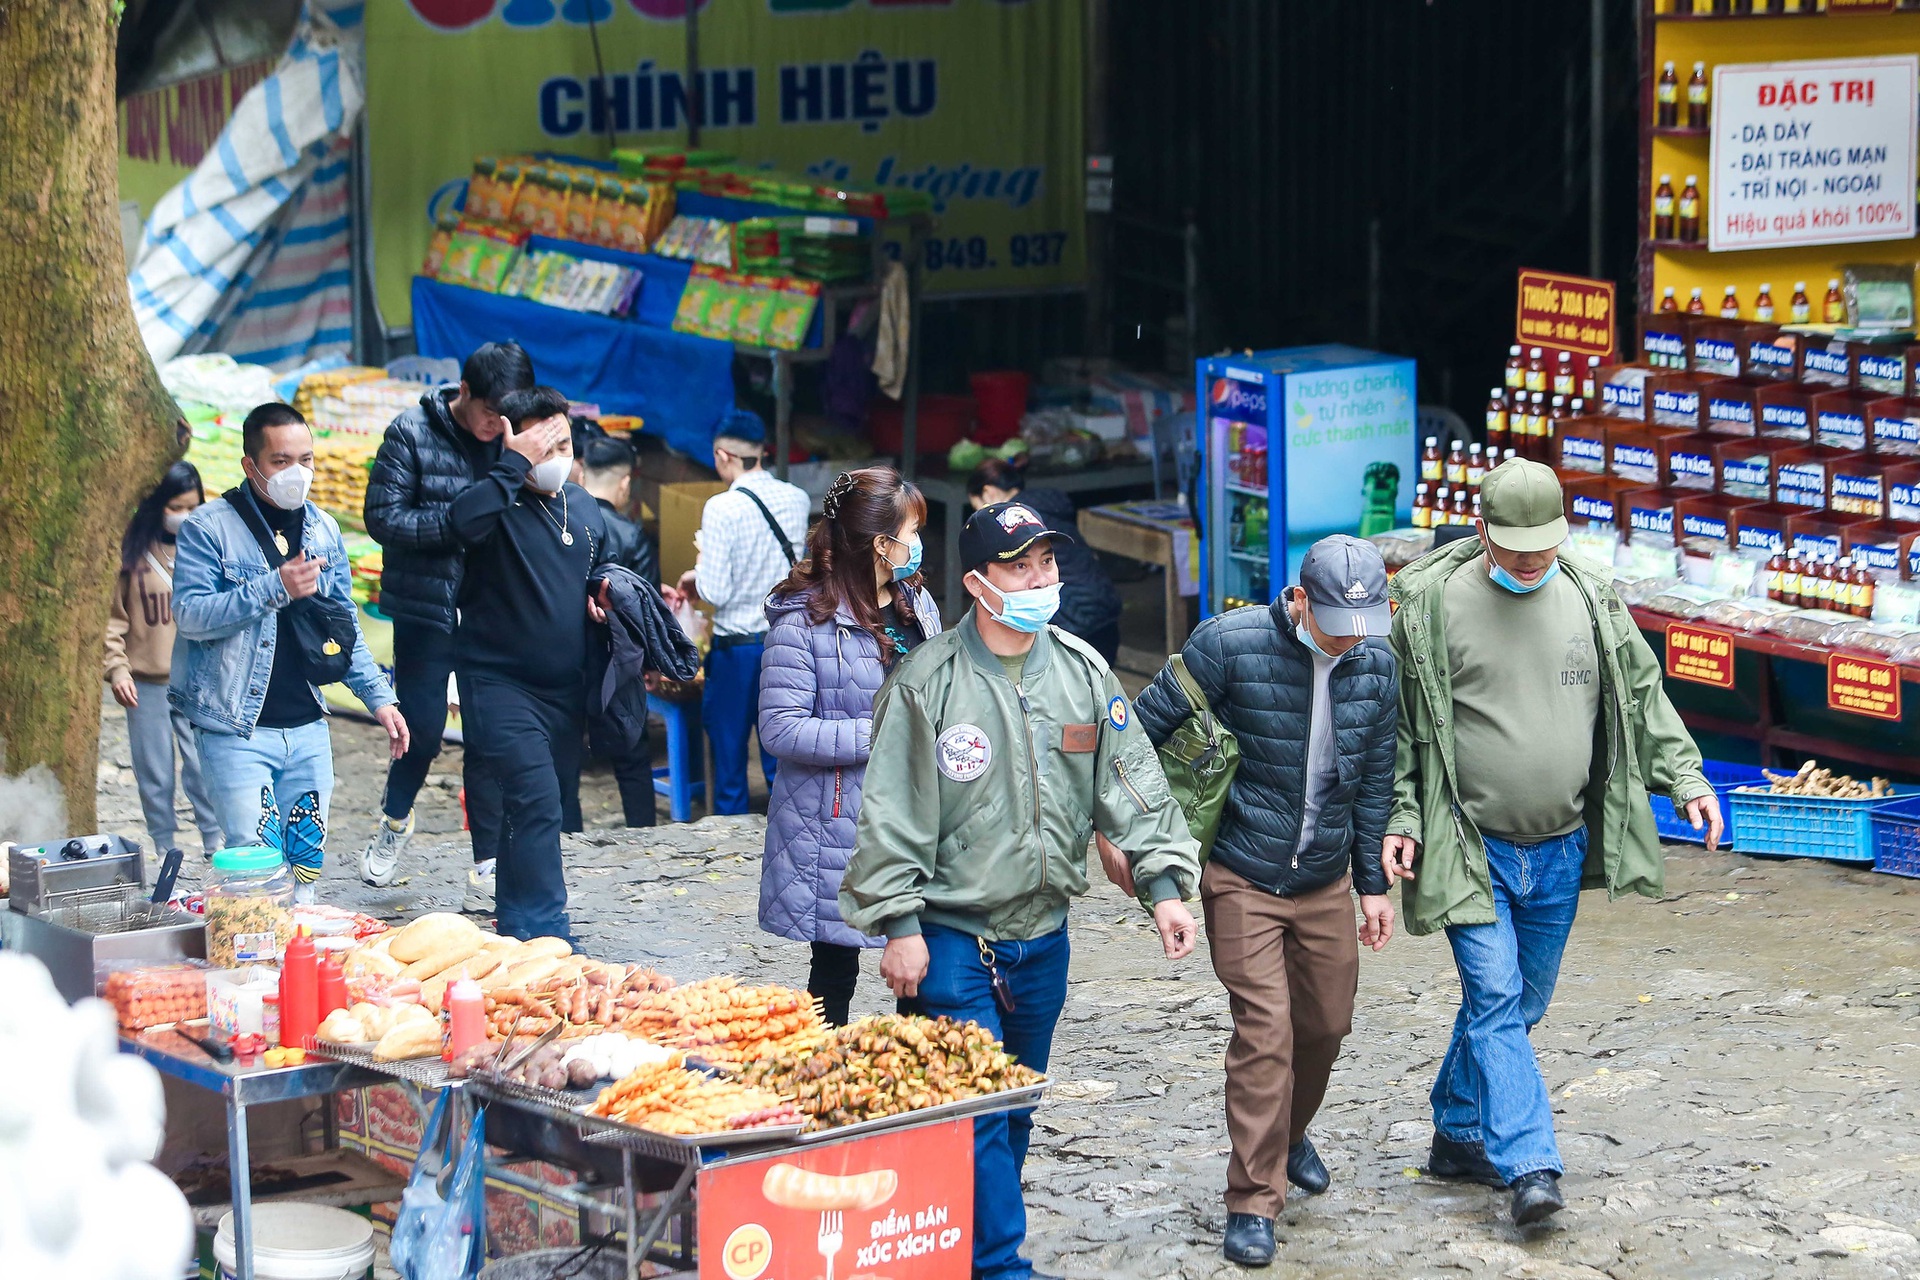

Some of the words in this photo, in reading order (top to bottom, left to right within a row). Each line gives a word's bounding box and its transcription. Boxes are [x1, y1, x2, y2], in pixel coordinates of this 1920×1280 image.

[539, 59, 757, 137] CHÍNH
[778, 49, 937, 134] HIỆU
[1757, 77, 1818, 110] ĐẶC
[1829, 79, 1875, 107] TRỊ
[1742, 124, 1767, 148] DẠ
[1774, 120, 1812, 141] DÀY
[1741, 150, 1772, 175] ĐẠI
[1780, 147, 1841, 168] TRÀNG
[1741, 178, 1770, 199] TRĨ
[1776, 177, 1807, 200] NỘI
[1823, 174, 1882, 195] NGOẠI
[1727, 211, 1766, 235] Hiệu
[1774, 209, 1806, 232] quả
[1857, 202, 1903, 225] 100%
[1010, 231, 1068, 266] 937
[1523, 280, 1560, 313] THUỐC
[1560, 290, 1584, 318] XOA
[1585, 290, 1609, 321] BÓP
[1299, 379, 1349, 399] hương
[1353, 368, 1404, 391] chanh
[1231, 390, 1266, 413] peps
[1319, 399, 1337, 421] tự
[1341, 397, 1386, 417] nhiên
[1292, 428, 1321, 448] cực
[1326, 422, 1373, 443] thanh
[1378, 418, 1411, 438] mát
[1345, 591, 1368, 599] adidas
[1561, 669, 1591, 686] USMC
[870, 1208, 911, 1239] ĐIỂM
[915, 1204, 948, 1229] BÁN
[731, 1242, 763, 1264] CP
[856, 1242, 892, 1268] XÚC
[896, 1231, 935, 1260] XÍCH
[939, 1226, 962, 1249] CP
